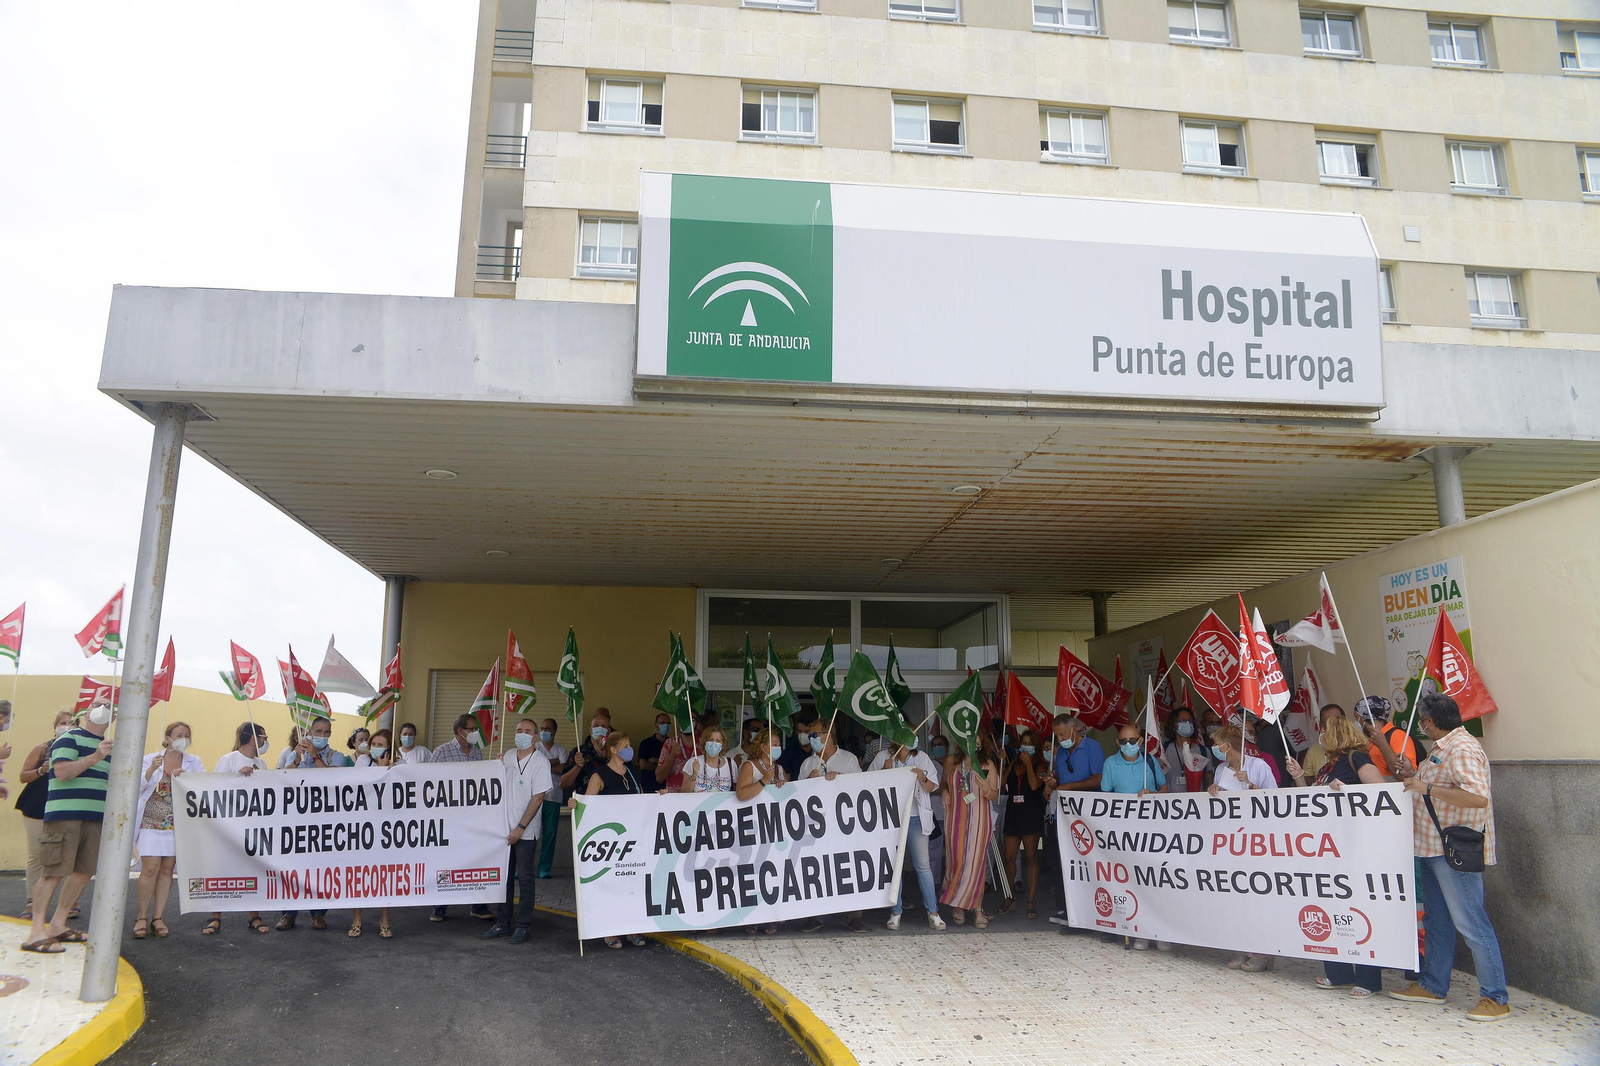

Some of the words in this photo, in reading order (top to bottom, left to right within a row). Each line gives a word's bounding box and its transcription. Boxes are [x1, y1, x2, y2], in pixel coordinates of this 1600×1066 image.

[1161, 269, 1352, 337] Hospital
[686, 331, 723, 346] JUNTA
[729, 333, 743, 347] DE
[1092, 335, 1186, 376] Punta
[1197, 341, 1234, 378] de
[1245, 342, 1354, 390] Europa
[1383, 586, 1429, 614] BUEN
[1430, 575, 1462, 604] DÍA
[1390, 571, 1412, 589] HOY
[1415, 567, 1430, 582] ES
[1431, 562, 1448, 578] UN
[1385, 613, 1403, 624] PARA
[1403, 608, 1427, 621] DEJAR
[1428, 606, 1437, 616] DE
[1201, 634, 1239, 672] UGT
[186, 787, 276, 818] SANIDAD
[283, 779, 368, 815] PÚBLICA
[373, 783, 386, 810] Y
[392, 781, 417, 810] DE
[423, 778, 502, 809] CALIDAD
[1060, 795, 1084, 817] EN
[1091, 798, 1201, 820] DEFENSA
[1209, 796, 1242, 820] DE
[1251, 790, 1402, 819] NUESTRA
[244, 827, 274, 857] UN
[281, 821, 375, 855] DERECHO
[380, 819, 449, 850] SOCIAL
[653, 795, 827, 855] ACABEMOS
[835, 787, 901, 836] CON
[1095, 829, 1204, 855] SANIDAD
[1212, 826, 1341, 858] PÚBLICA
[280, 869, 300, 900] NO
[304, 868, 313, 900] A
[317, 866, 342, 900] LOS
[345, 863, 411, 899] RECORTES
[414, 863, 426, 895] !!!
[644, 871, 685, 917] LA
[694, 845, 899, 913] PRECARIEDA
[1096, 861, 1129, 884] NO
[1134, 861, 1189, 890] MÁS
[1196, 869, 1353, 900] RECORTES
[1365, 873, 1407, 902] !!!
[1303, 911, 1324, 923] UGT
